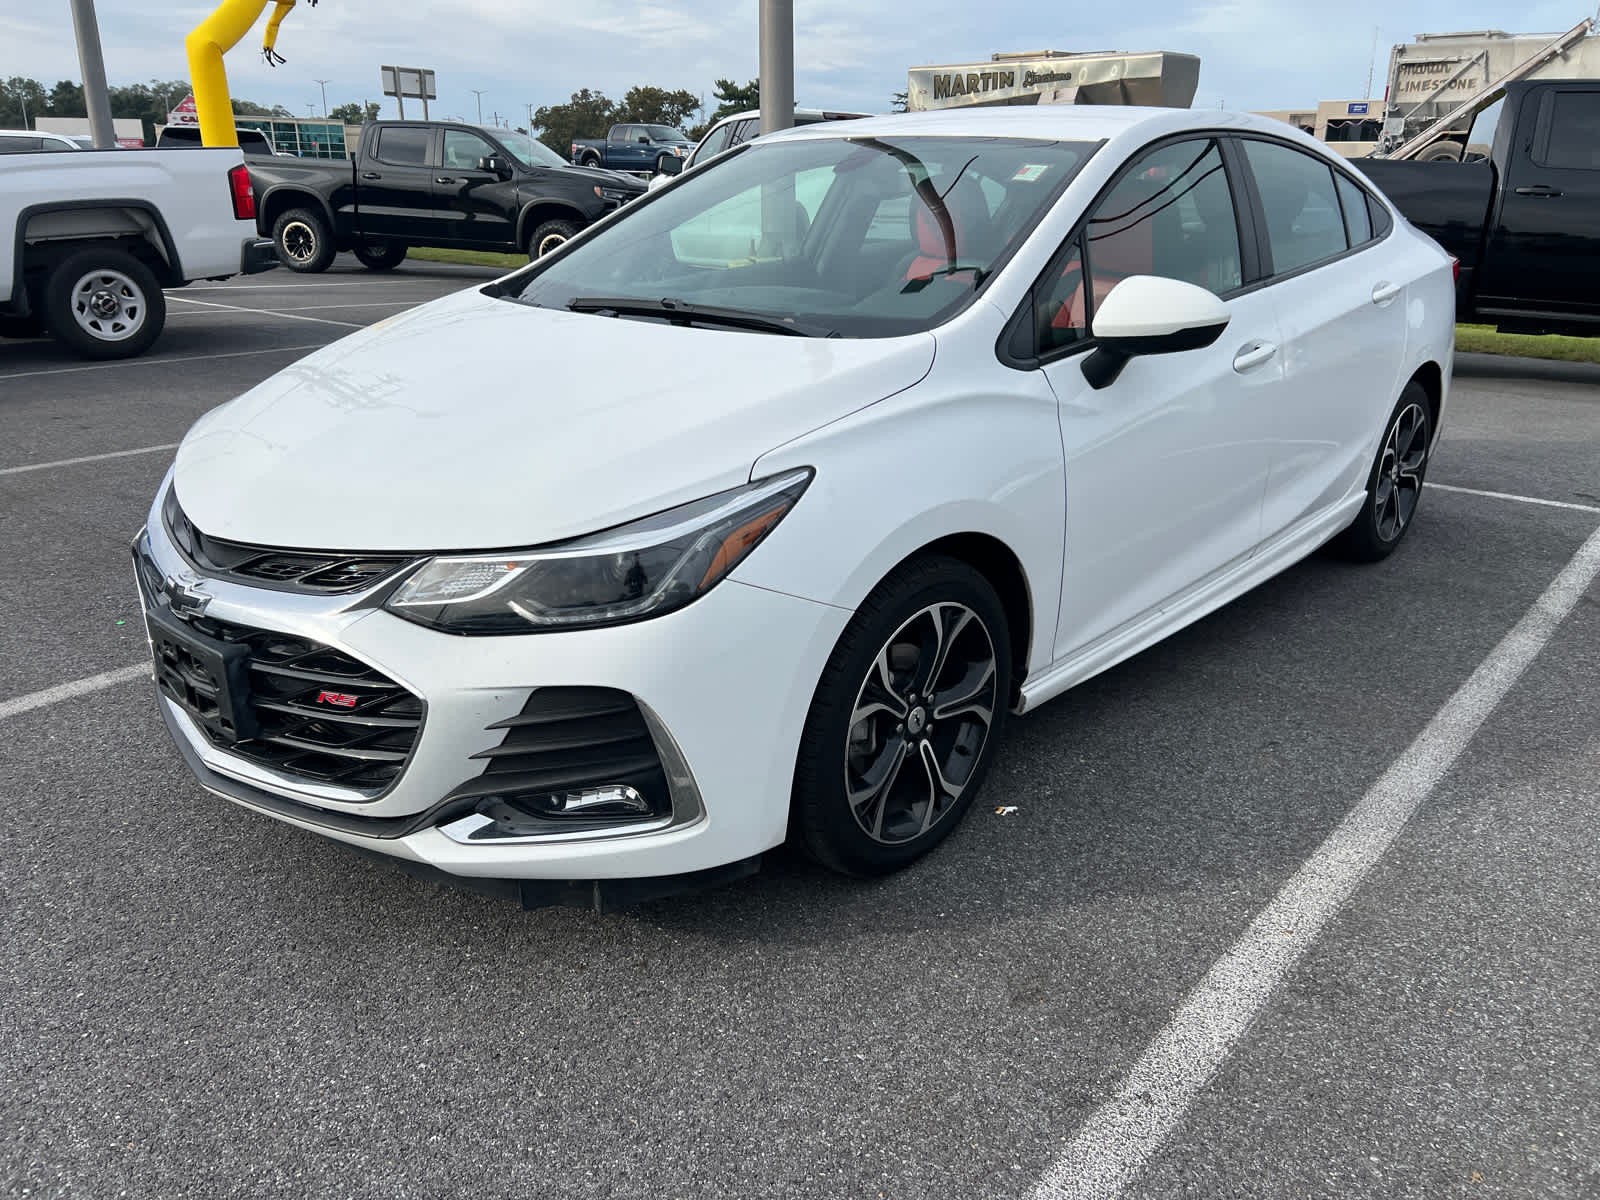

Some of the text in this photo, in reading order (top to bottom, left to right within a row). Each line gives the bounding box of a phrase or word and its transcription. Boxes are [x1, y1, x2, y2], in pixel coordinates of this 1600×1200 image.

[934, 70, 1071, 99] MARTIN Limestone
[180, 115, 199, 123] CA
[317, 691, 358, 707] RS
